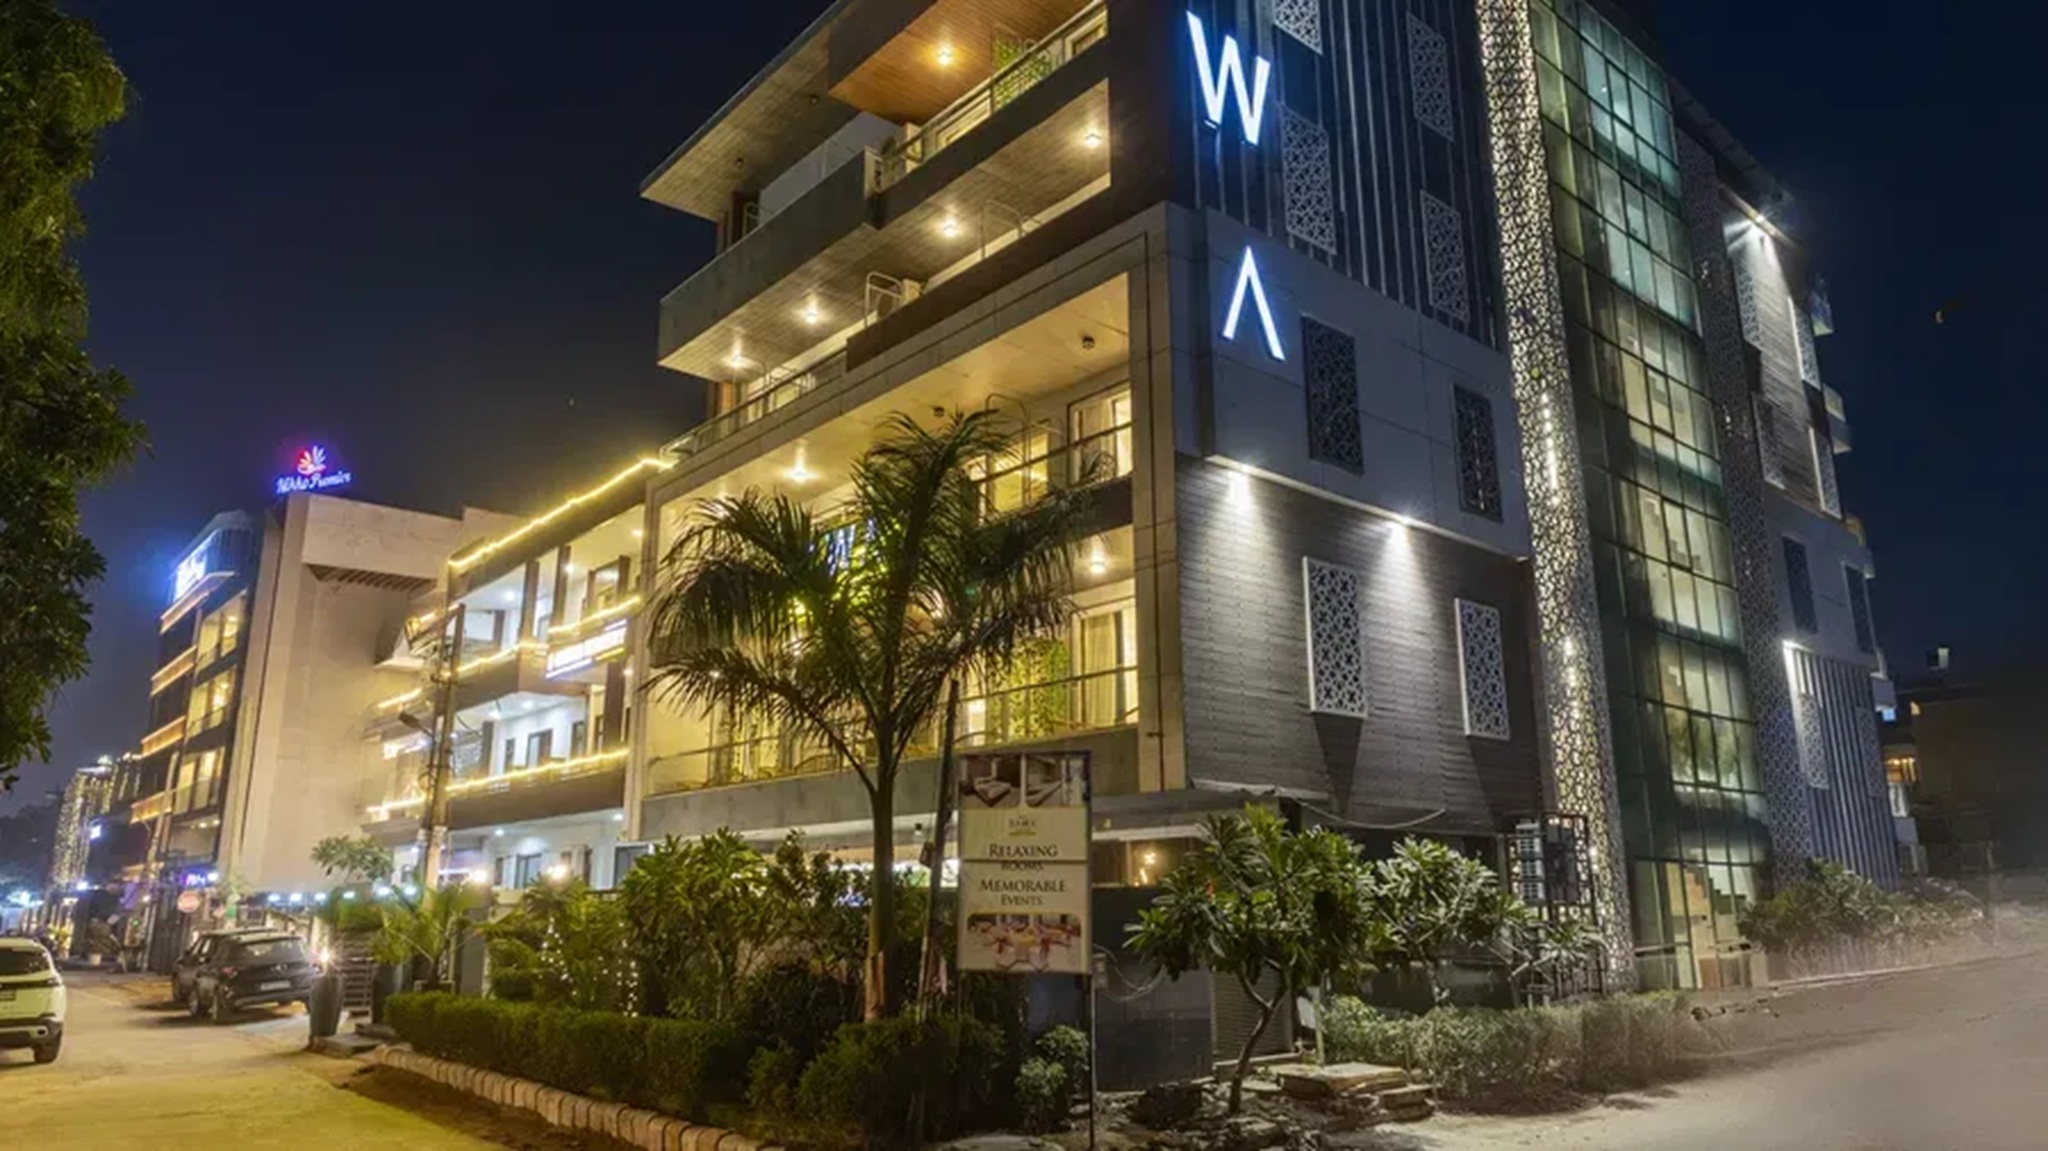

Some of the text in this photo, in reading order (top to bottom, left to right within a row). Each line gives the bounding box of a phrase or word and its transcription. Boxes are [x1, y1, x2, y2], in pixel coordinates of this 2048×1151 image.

[988, 843, 1059, 858] RELAXING
[979, 879, 1067, 893] MEMORABLE
[1001, 894, 1044, 906] EVENTS
